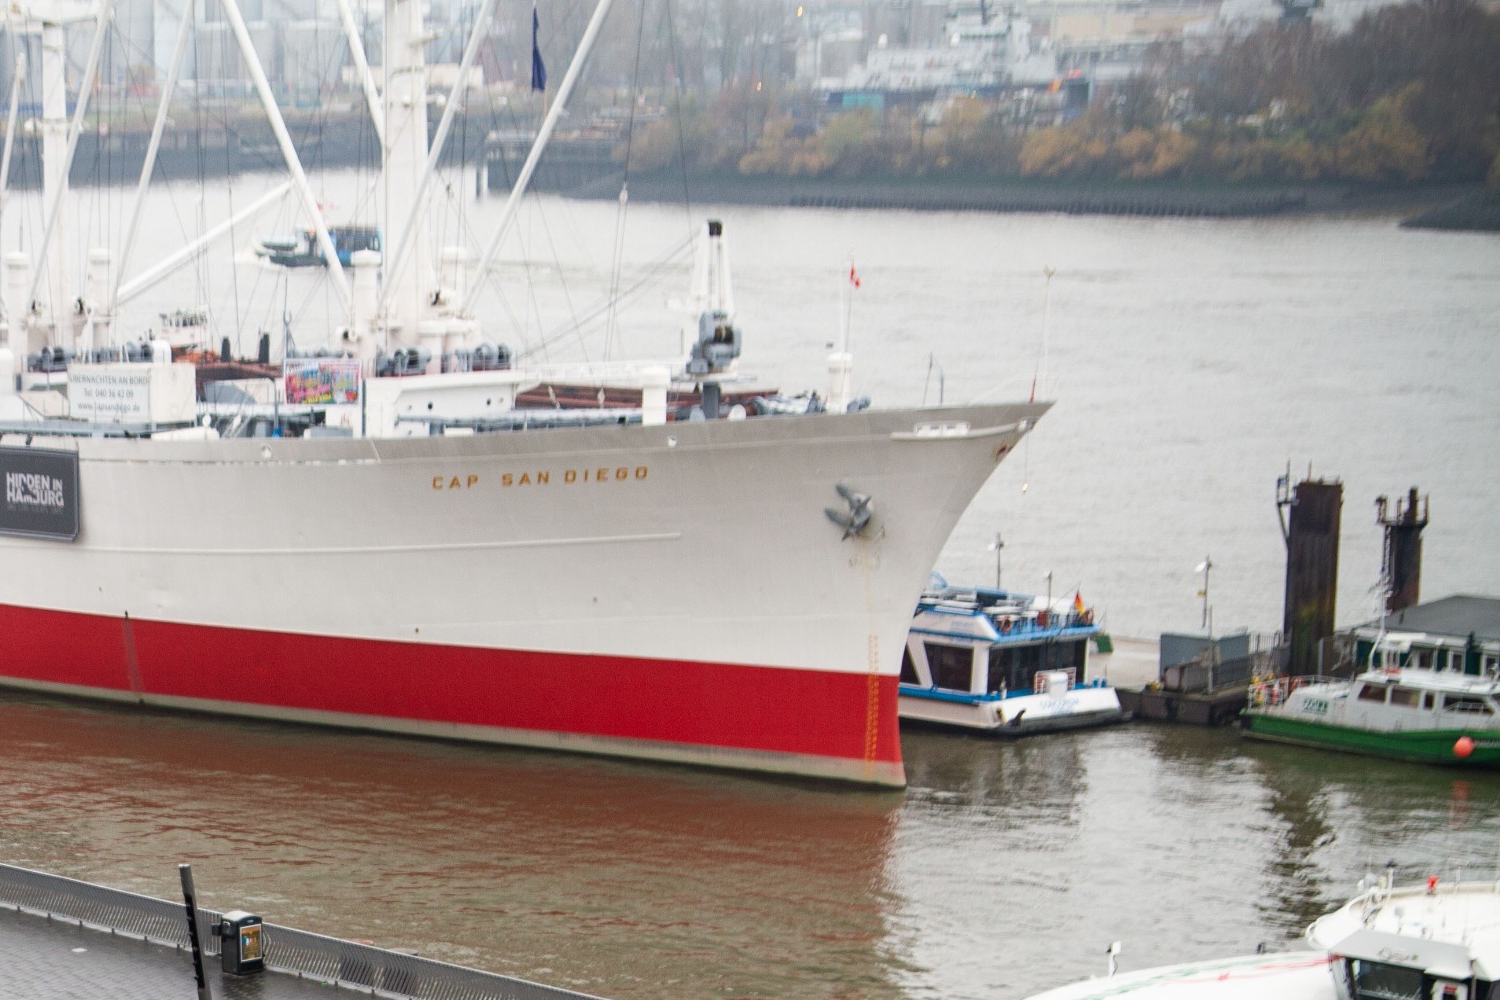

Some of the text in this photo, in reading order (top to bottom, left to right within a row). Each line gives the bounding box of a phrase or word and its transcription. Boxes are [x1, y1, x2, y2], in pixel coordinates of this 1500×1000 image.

[118, 375, 128, 385] AN
[6, 471, 64, 492] HIDDEN IN
[431, 465, 649, 490] CAP SAN DIEGO
